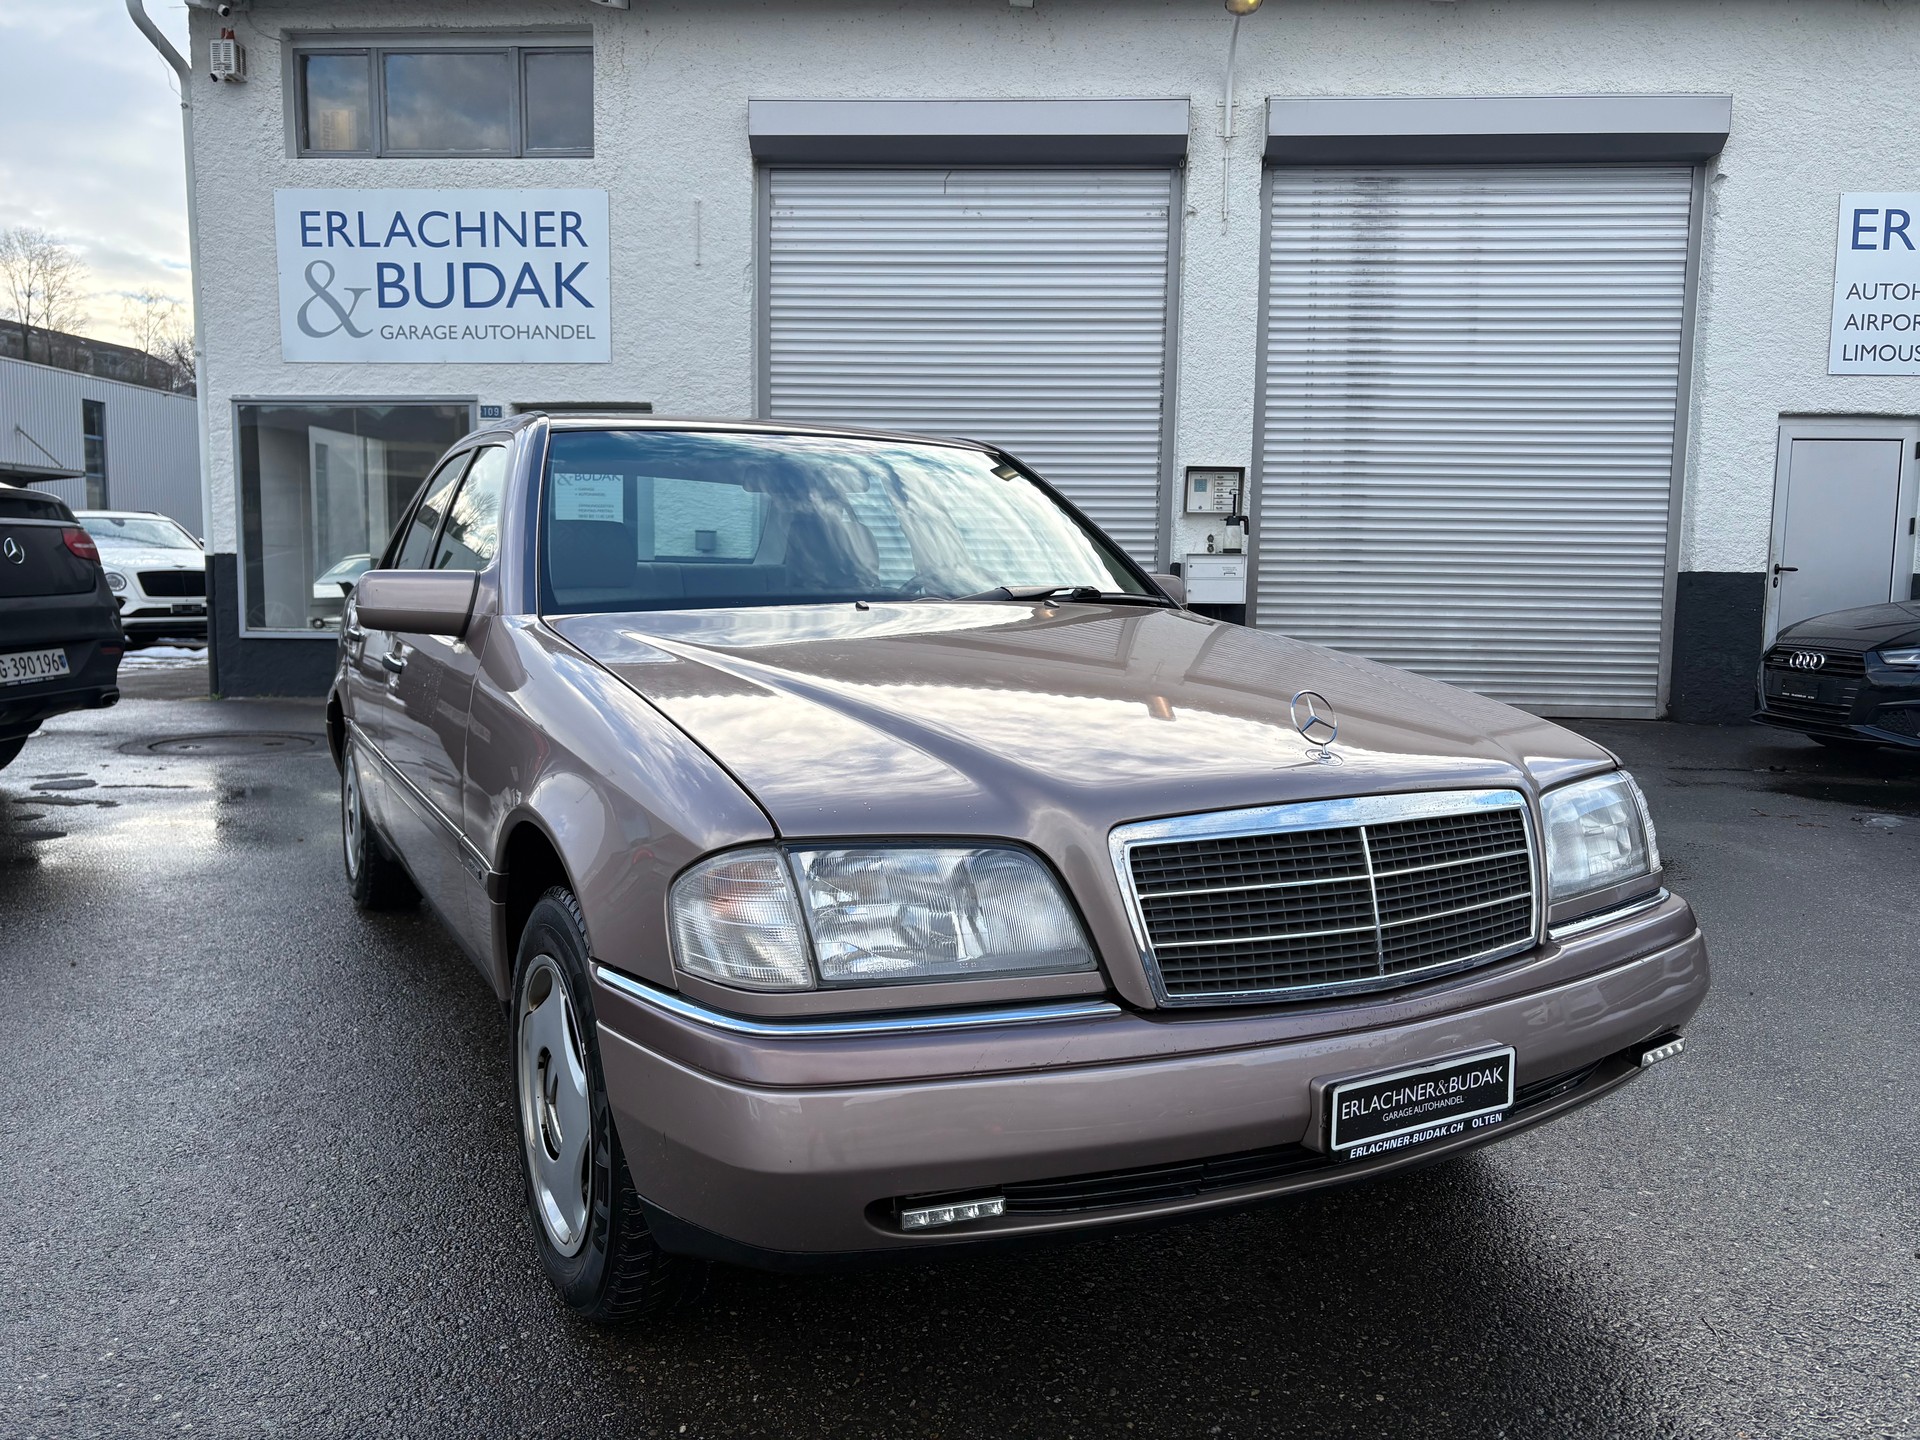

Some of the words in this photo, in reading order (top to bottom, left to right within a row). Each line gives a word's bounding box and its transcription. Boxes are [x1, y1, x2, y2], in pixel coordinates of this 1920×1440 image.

[299, 210, 589, 248] ERLACHNER
[1851, 208, 1917, 251] ER
[296, 259, 374, 339] &
[376, 261, 596, 309] BUDAK
[379, 324, 458, 341] GARAGE
[461, 324, 596, 341] AUTOHANDEL
[1843, 313, 1920, 332] AIRPOR
[483, 407, 500, 417] 109
[1382, 1107, 1413, 1122] GARAGE
[1413, 1095, 1465, 1114] AUTOHANDEL
[1350, 1121, 1464, 1159] ERLACHNER-BUDAK.CH
[1471, 1112, 1502, 1129] OLTEN
